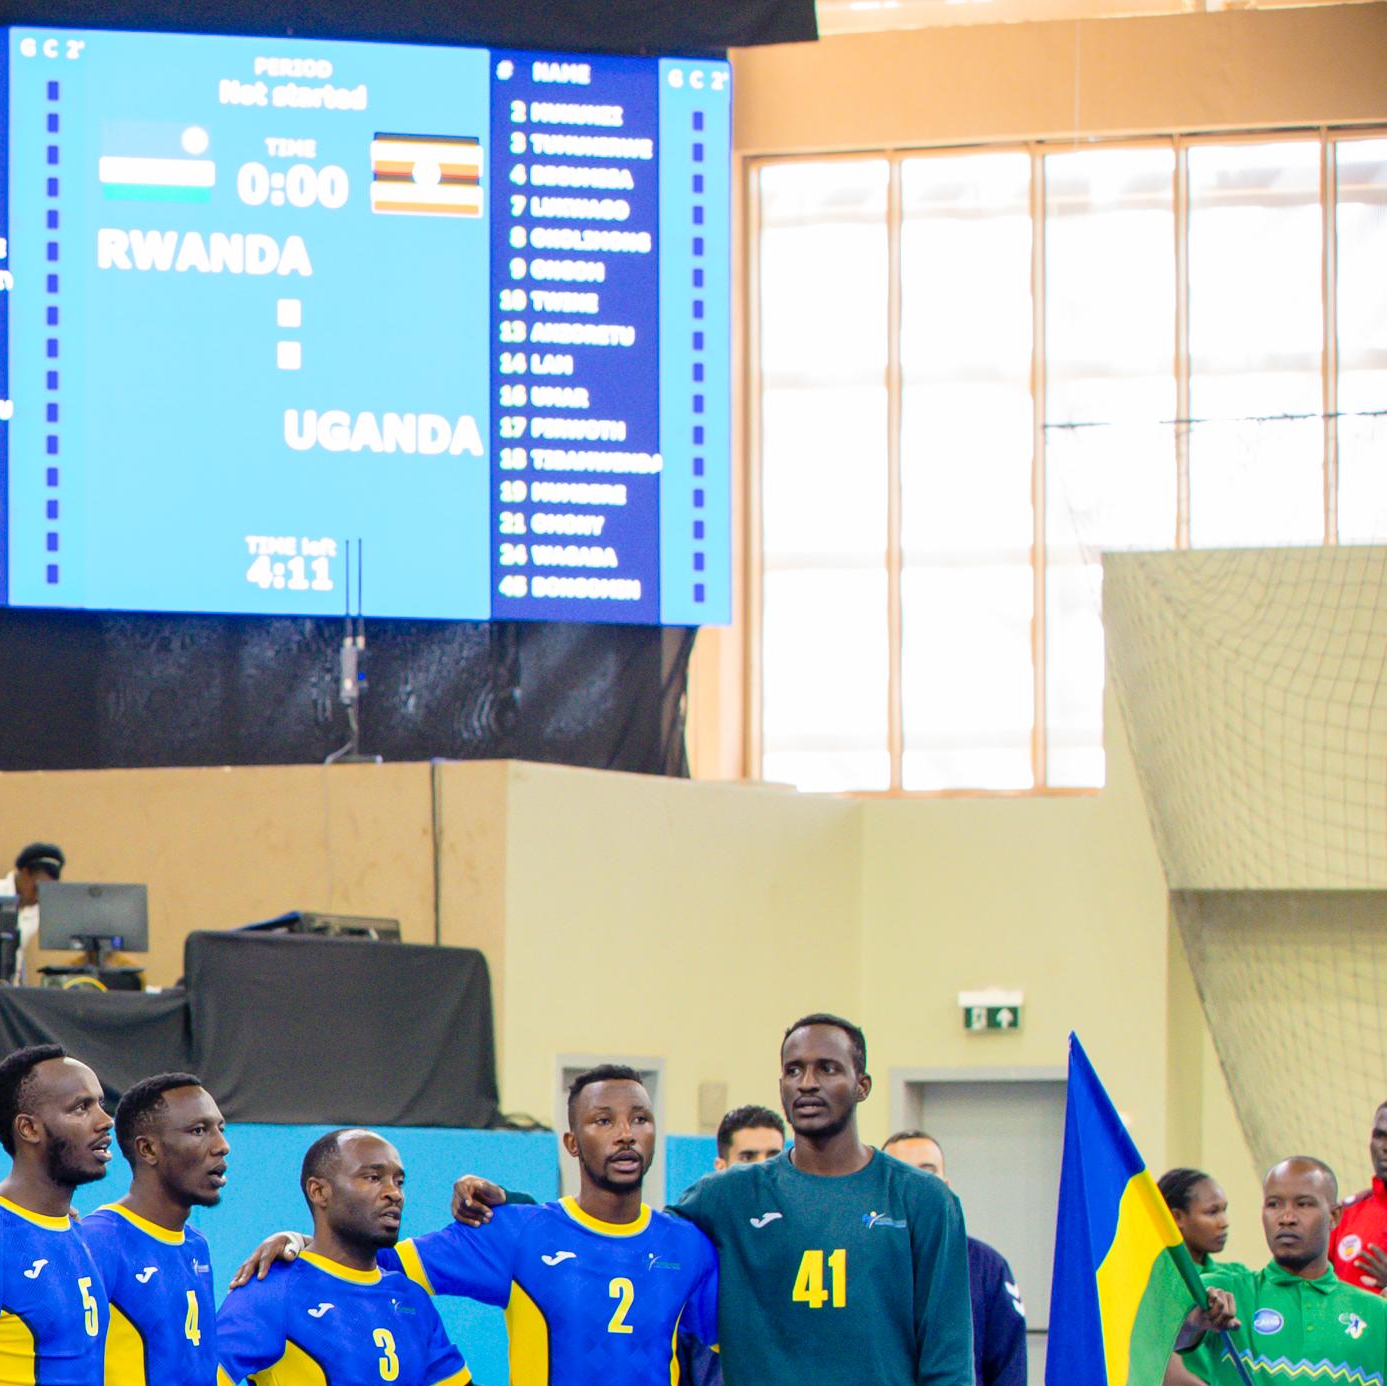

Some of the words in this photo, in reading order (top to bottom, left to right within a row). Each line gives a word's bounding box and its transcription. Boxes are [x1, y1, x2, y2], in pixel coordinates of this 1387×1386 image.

[254, 56, 334, 80] PERIOD
[533, 62, 591, 84] NAME
[218, 78, 269, 107] Not
[271, 82, 368, 111] started
[511, 99, 527, 122] 2
[264, 136, 317, 159] TIME
[237, 161, 350, 209] 0:00
[510, 163, 528, 185] 4
[511, 194, 527, 216] 7
[98, 228, 313, 277] RWANDA
[500, 288, 528, 310] 10
[500, 351, 528, 373] 14
[283, 408, 485, 457] UGANDA
[500, 416, 528, 438] 17
[500, 511, 527, 534] 21
[244, 535, 298, 556] TIME
[500, 542, 528, 565] 24
[245, 555, 335, 592] 4:11
[792, 1248, 846, 1309] 41
[77, 1276, 99, 1337] 5
[607, 1277, 635, 1334] 2
[184, 1290, 201, 1346] 4
[372, 1328, 400, 1382] 3
